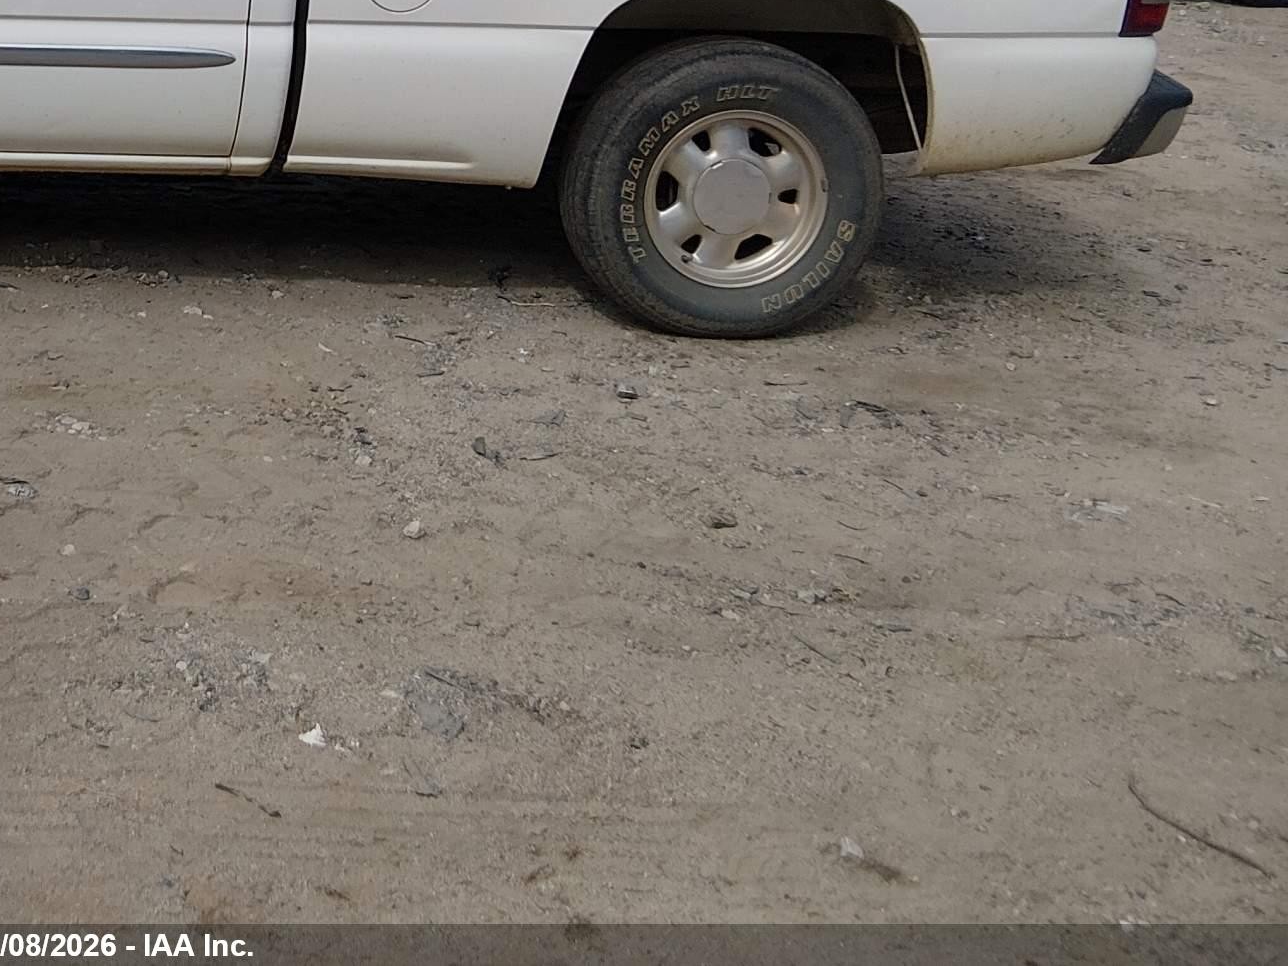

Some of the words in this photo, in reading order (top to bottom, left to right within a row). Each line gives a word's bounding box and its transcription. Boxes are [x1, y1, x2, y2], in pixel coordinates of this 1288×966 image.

[620, 96, 700, 263] TERRAMAX
[716, 85, 780, 102] HLT
[761, 220, 855, 313] SAILUN
